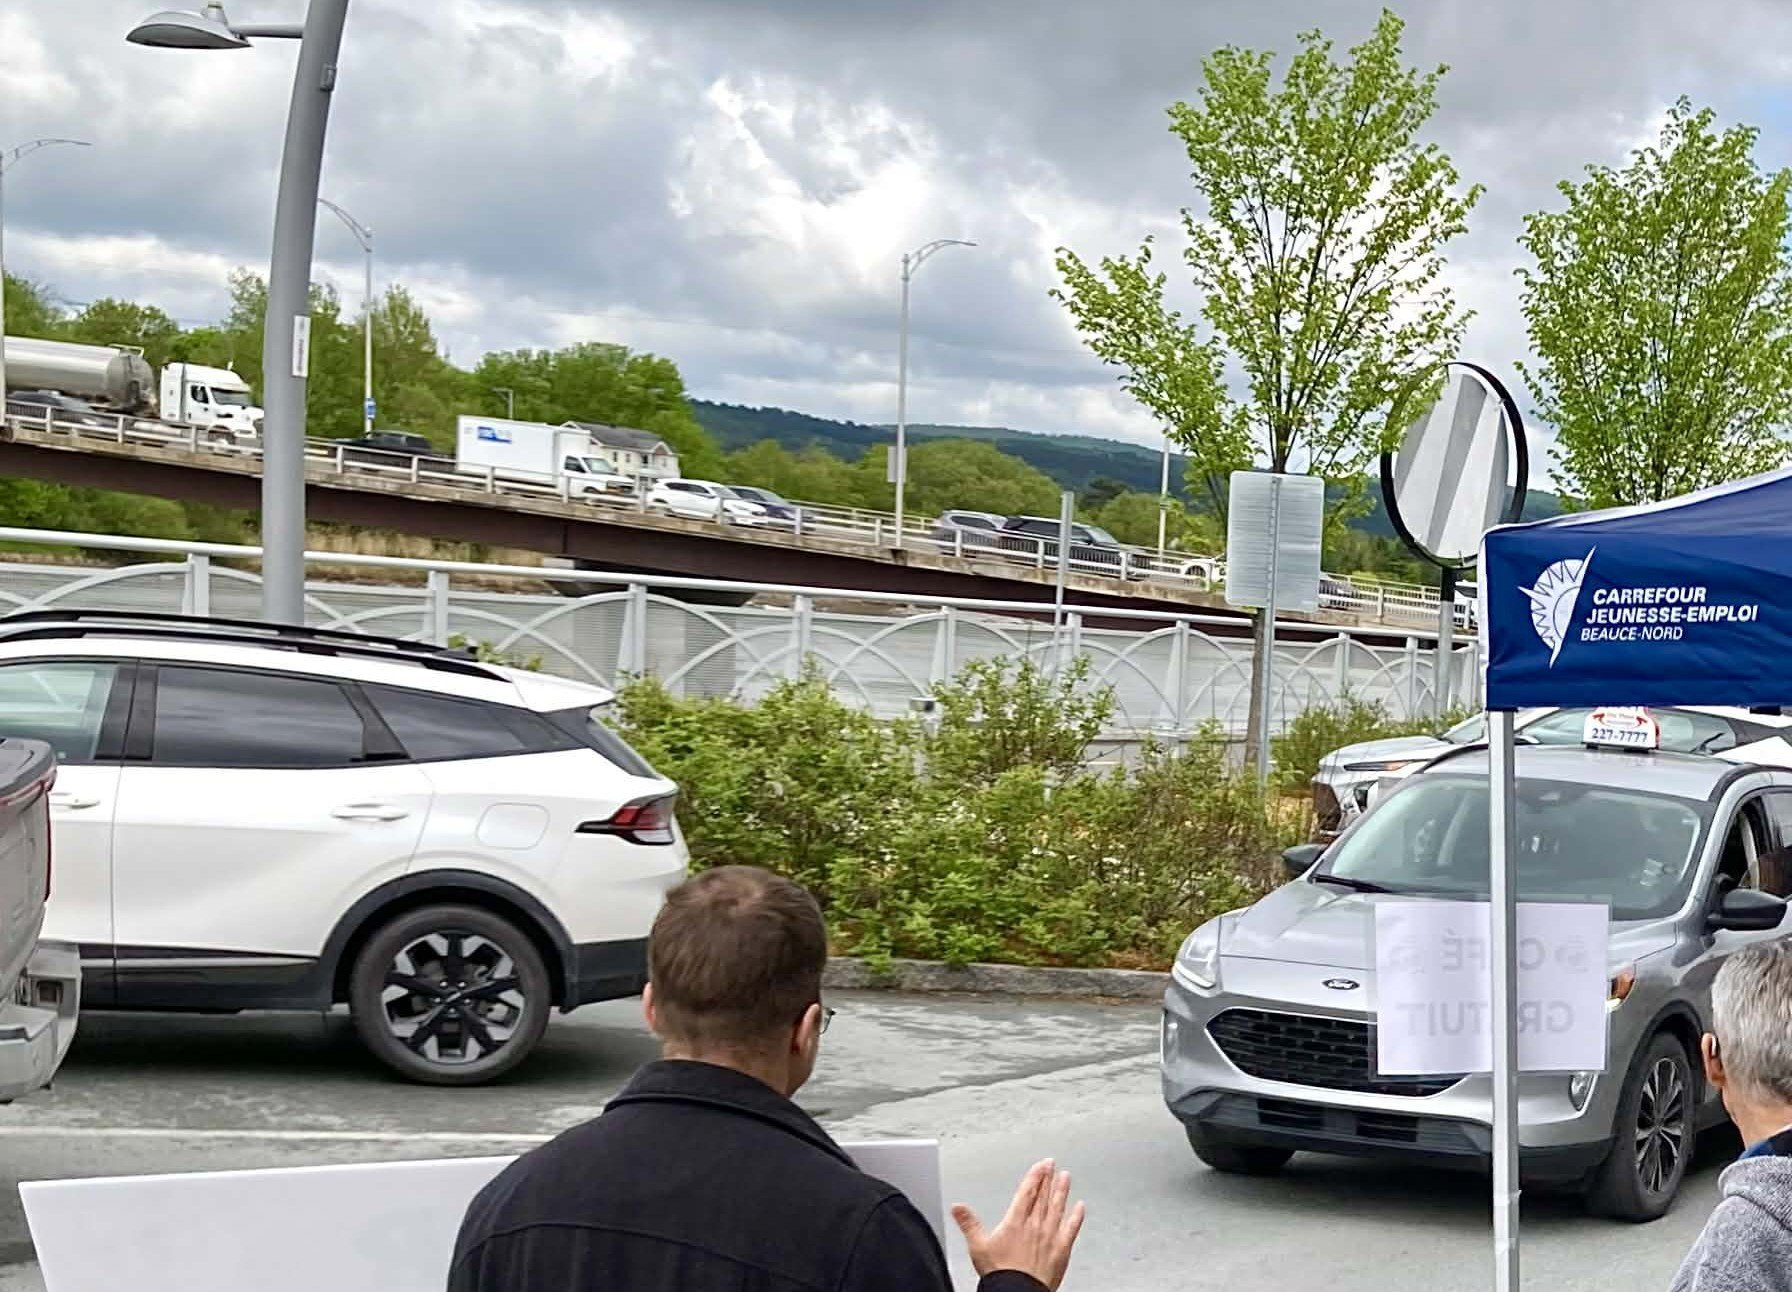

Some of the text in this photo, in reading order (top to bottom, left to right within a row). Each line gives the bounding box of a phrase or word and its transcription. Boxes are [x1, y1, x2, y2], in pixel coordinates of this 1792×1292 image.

[1593, 587, 1706, 605] CARREFOUR
[1586, 605, 1758, 624] JEUNESSE-EMPLOI
[1581, 627, 1683, 641] BEAUCE-NORD
[1592, 727, 1648, 743] 227-7777
